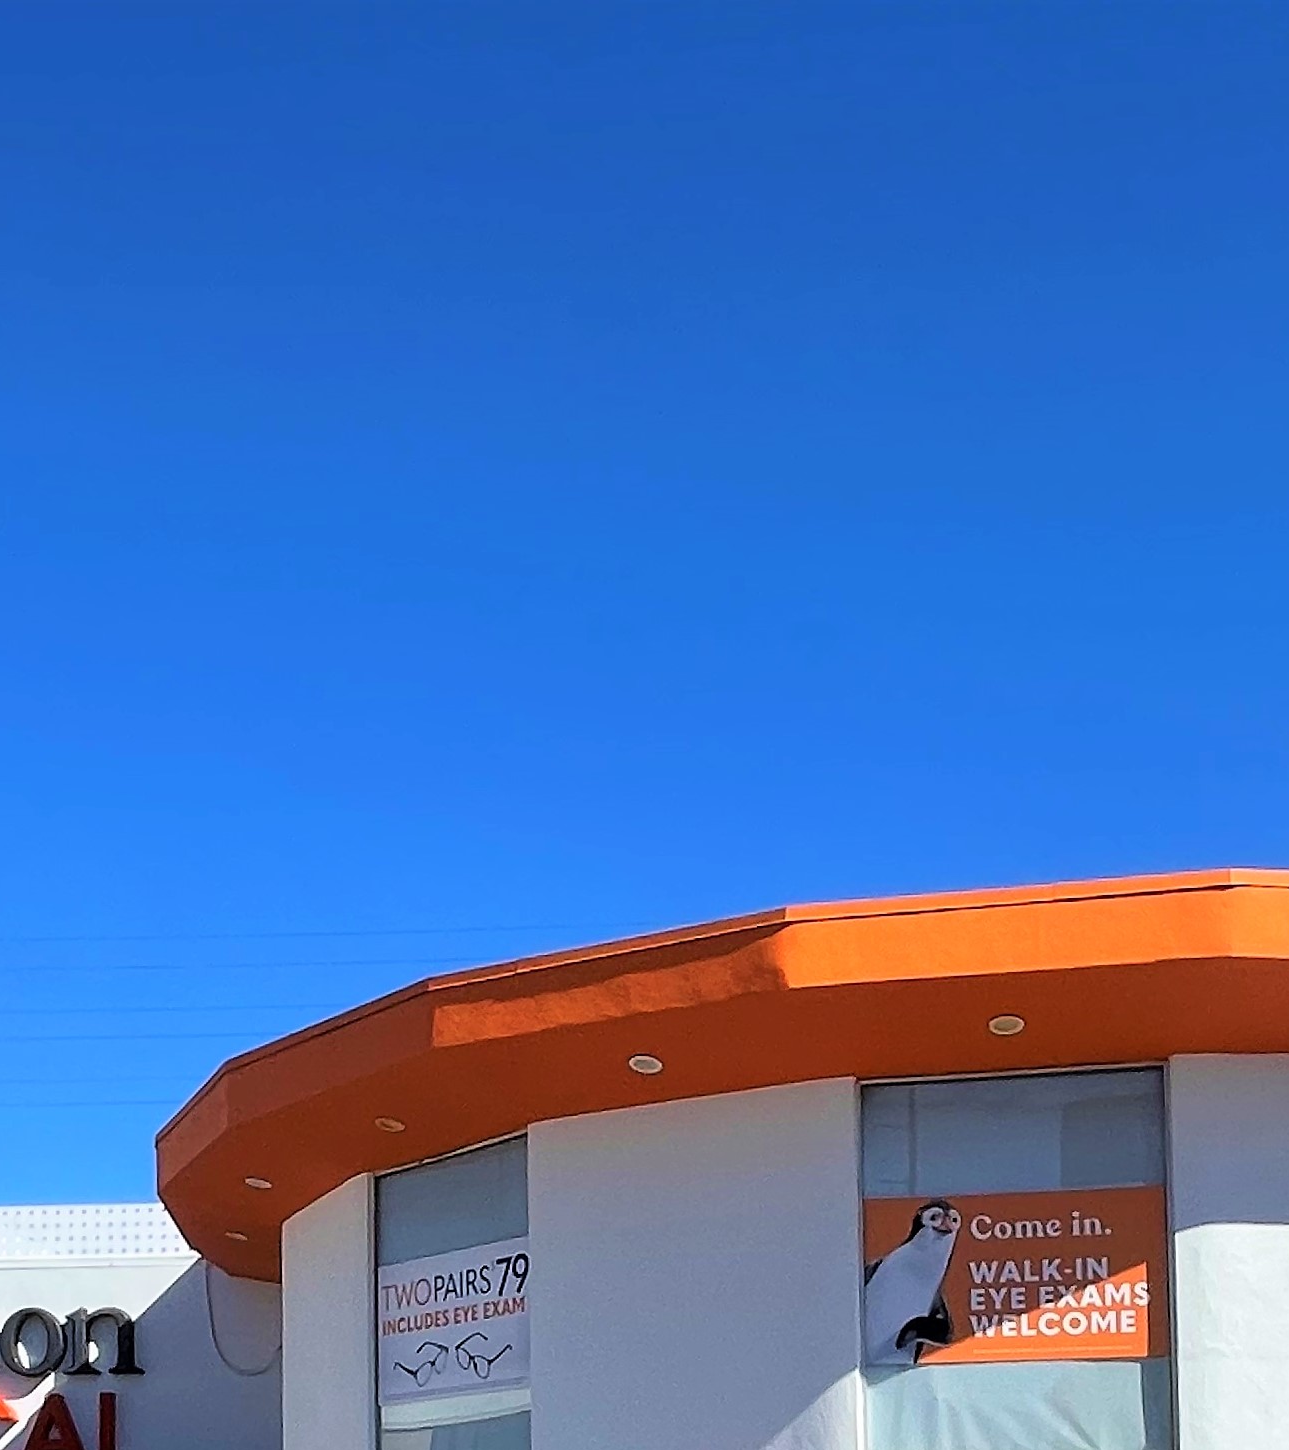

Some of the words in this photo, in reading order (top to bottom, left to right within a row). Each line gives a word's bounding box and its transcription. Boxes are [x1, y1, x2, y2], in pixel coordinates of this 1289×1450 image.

[970, 1214, 1062, 1240] Come
[1071, 1211, 1112, 1237] in.
[969, 1256, 1110, 1284] WALK-IN
[970, 1286, 1027, 1311] EYE
[1038, 1281, 1151, 1309] EXAMS
[382, 1309, 450, 1336] INCLUDES
[453, 1303, 479, 1325] EYE
[483, 1296, 526, 1319] EXAM
[969, 1310, 1138, 1338] WELCOME
